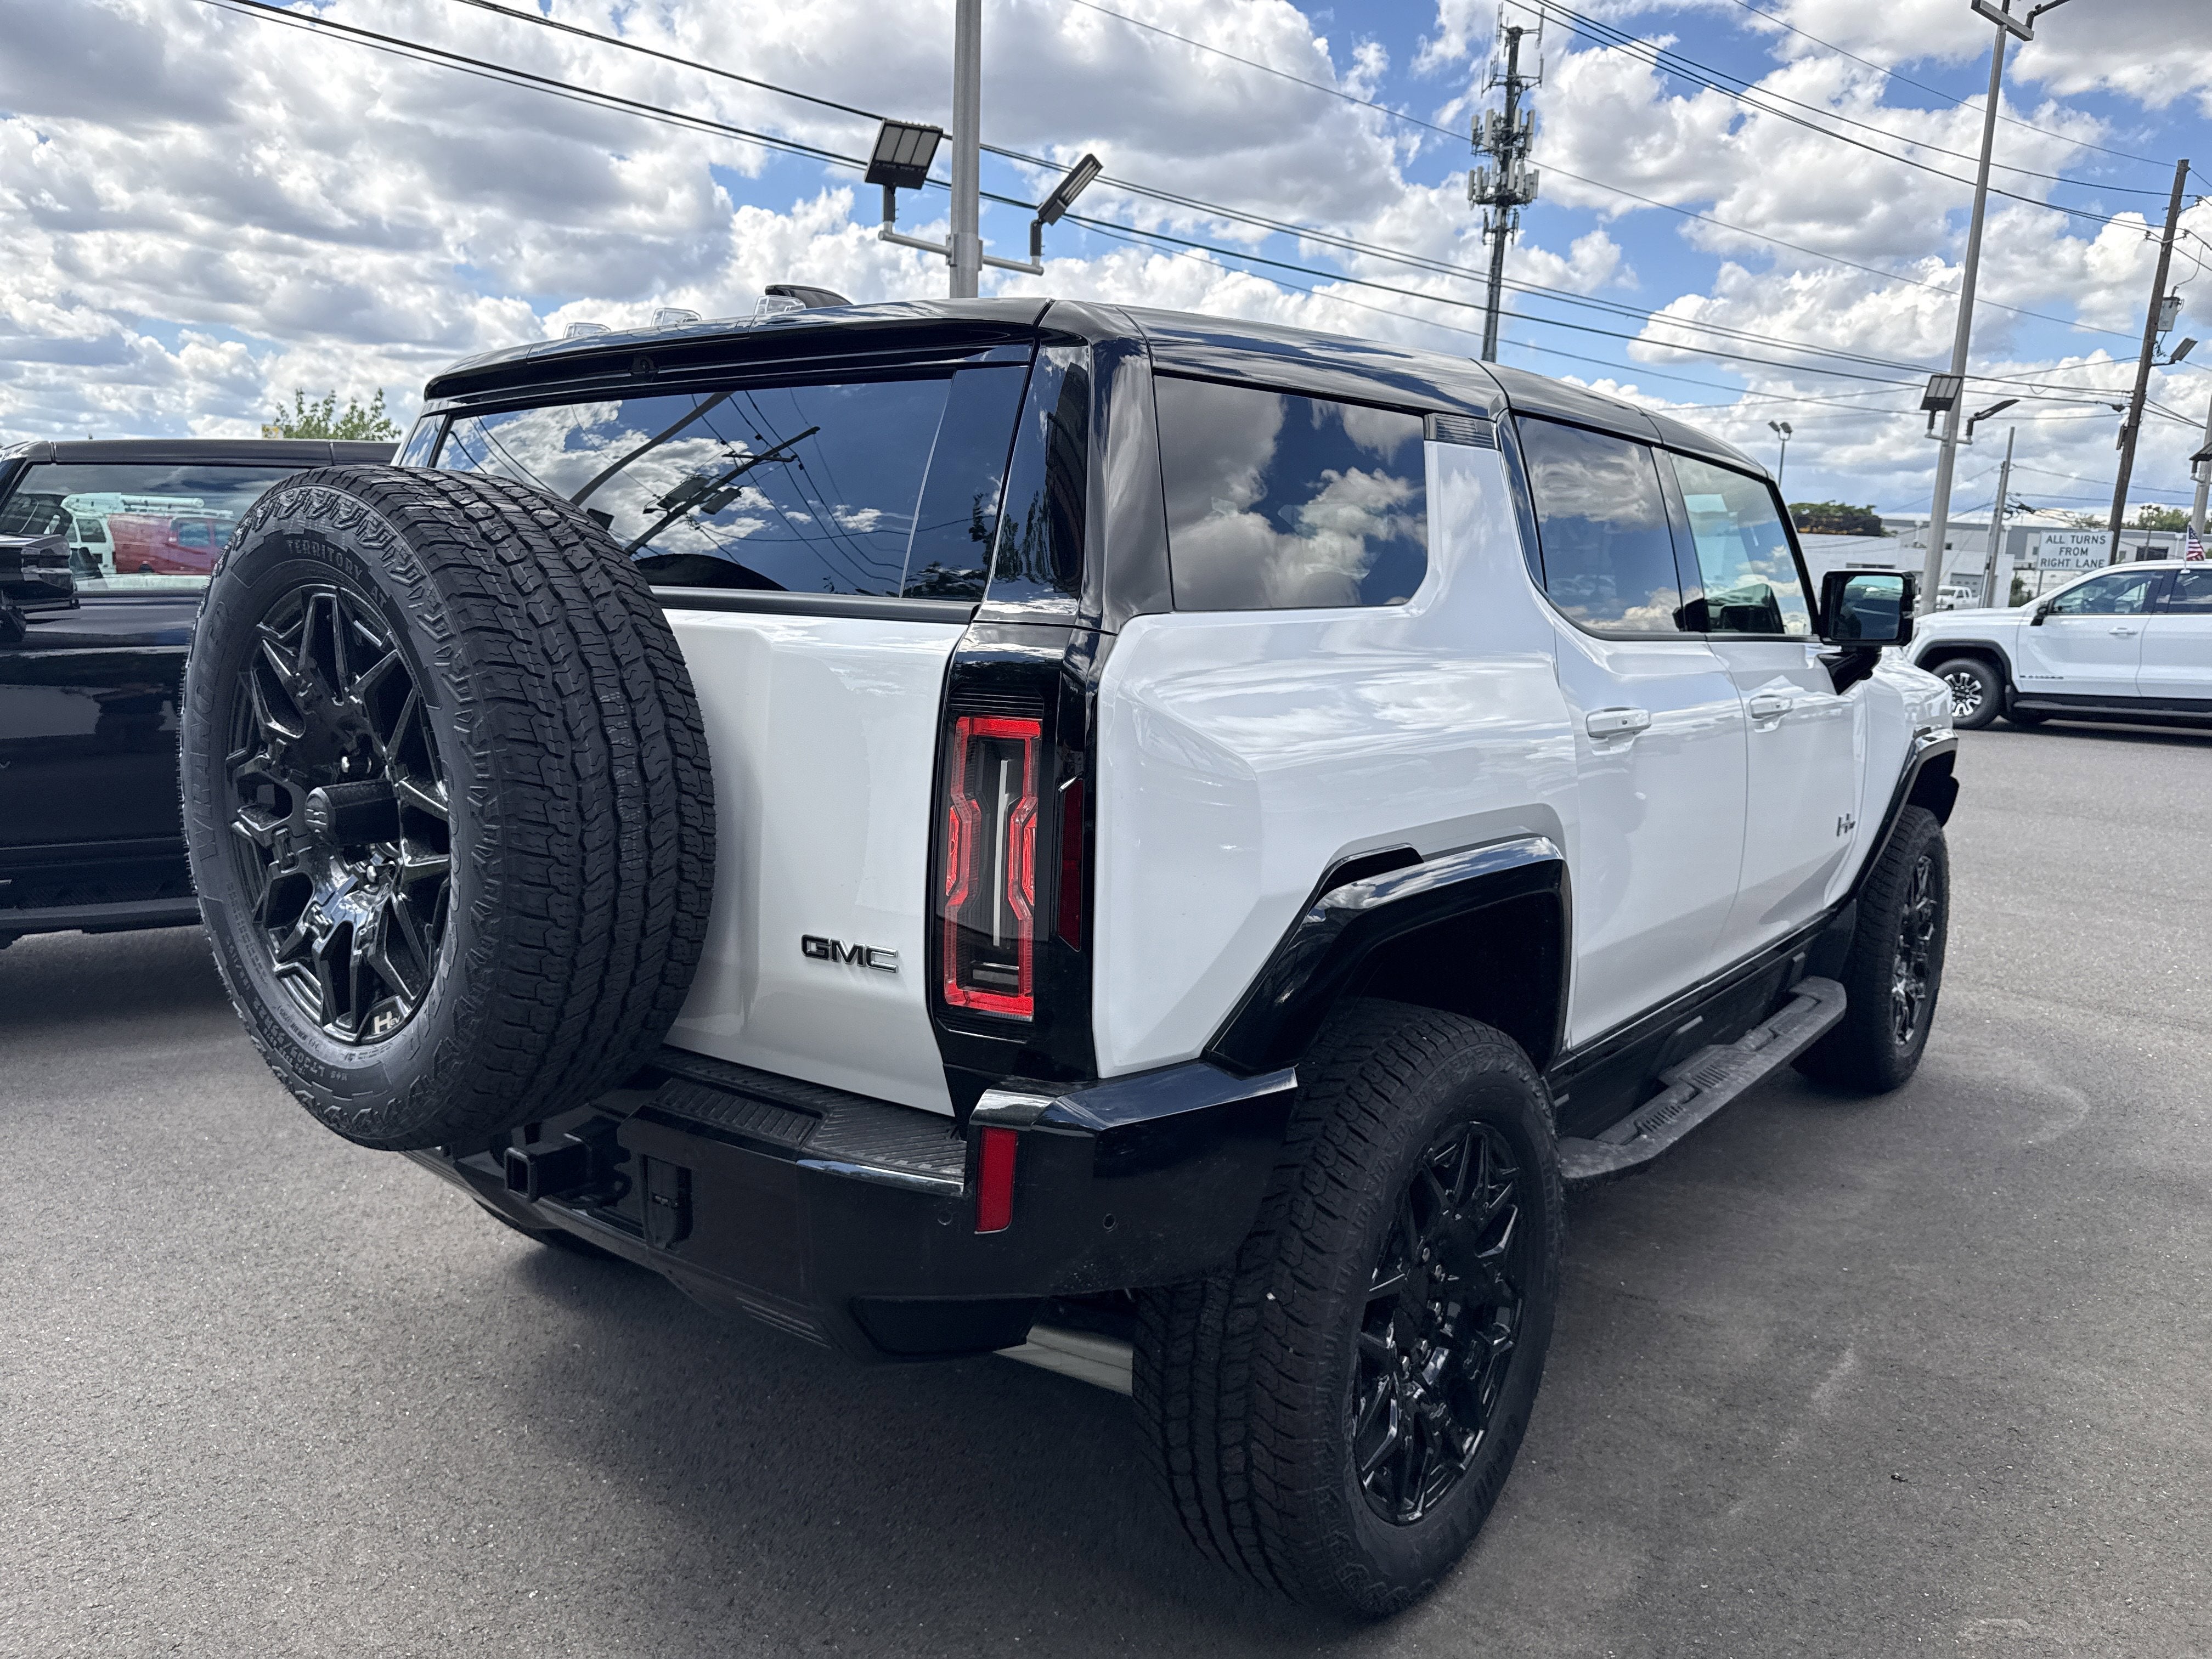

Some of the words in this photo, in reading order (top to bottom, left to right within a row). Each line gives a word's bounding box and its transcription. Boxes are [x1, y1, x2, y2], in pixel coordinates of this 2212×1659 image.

[2045, 535, 2065, 544] ALL
[2070, 535, 2106, 545] TURNS
[2059, 546, 2088, 556] FROM
[2040, 558, 2071, 567] RIGHT
[2076, 558, 2105, 568] LANE
[286, 539, 362, 580] TERRITORY
[370, 585, 387, 608] AT
[802, 934, 899, 974] GMC
